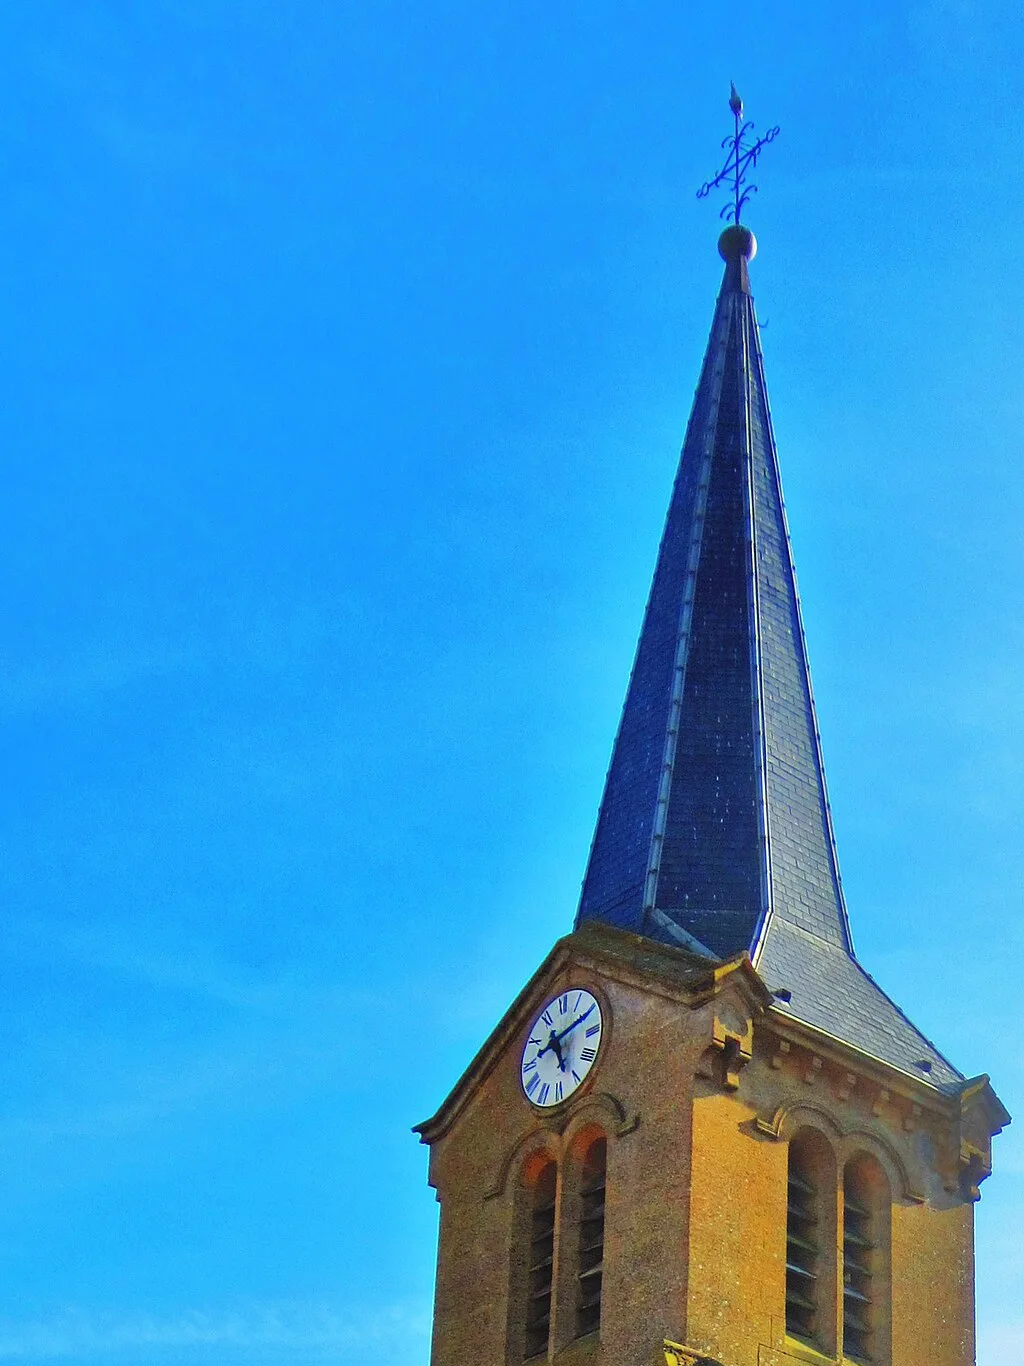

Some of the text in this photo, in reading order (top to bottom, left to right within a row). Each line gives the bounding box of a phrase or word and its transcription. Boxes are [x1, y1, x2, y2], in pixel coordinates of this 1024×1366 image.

[541, 1010, 553, 1026] XI
[586, 1024, 600, 1038] III
[529, 1037, 542, 1045] X
[572, 1070, 581, 1085] V
